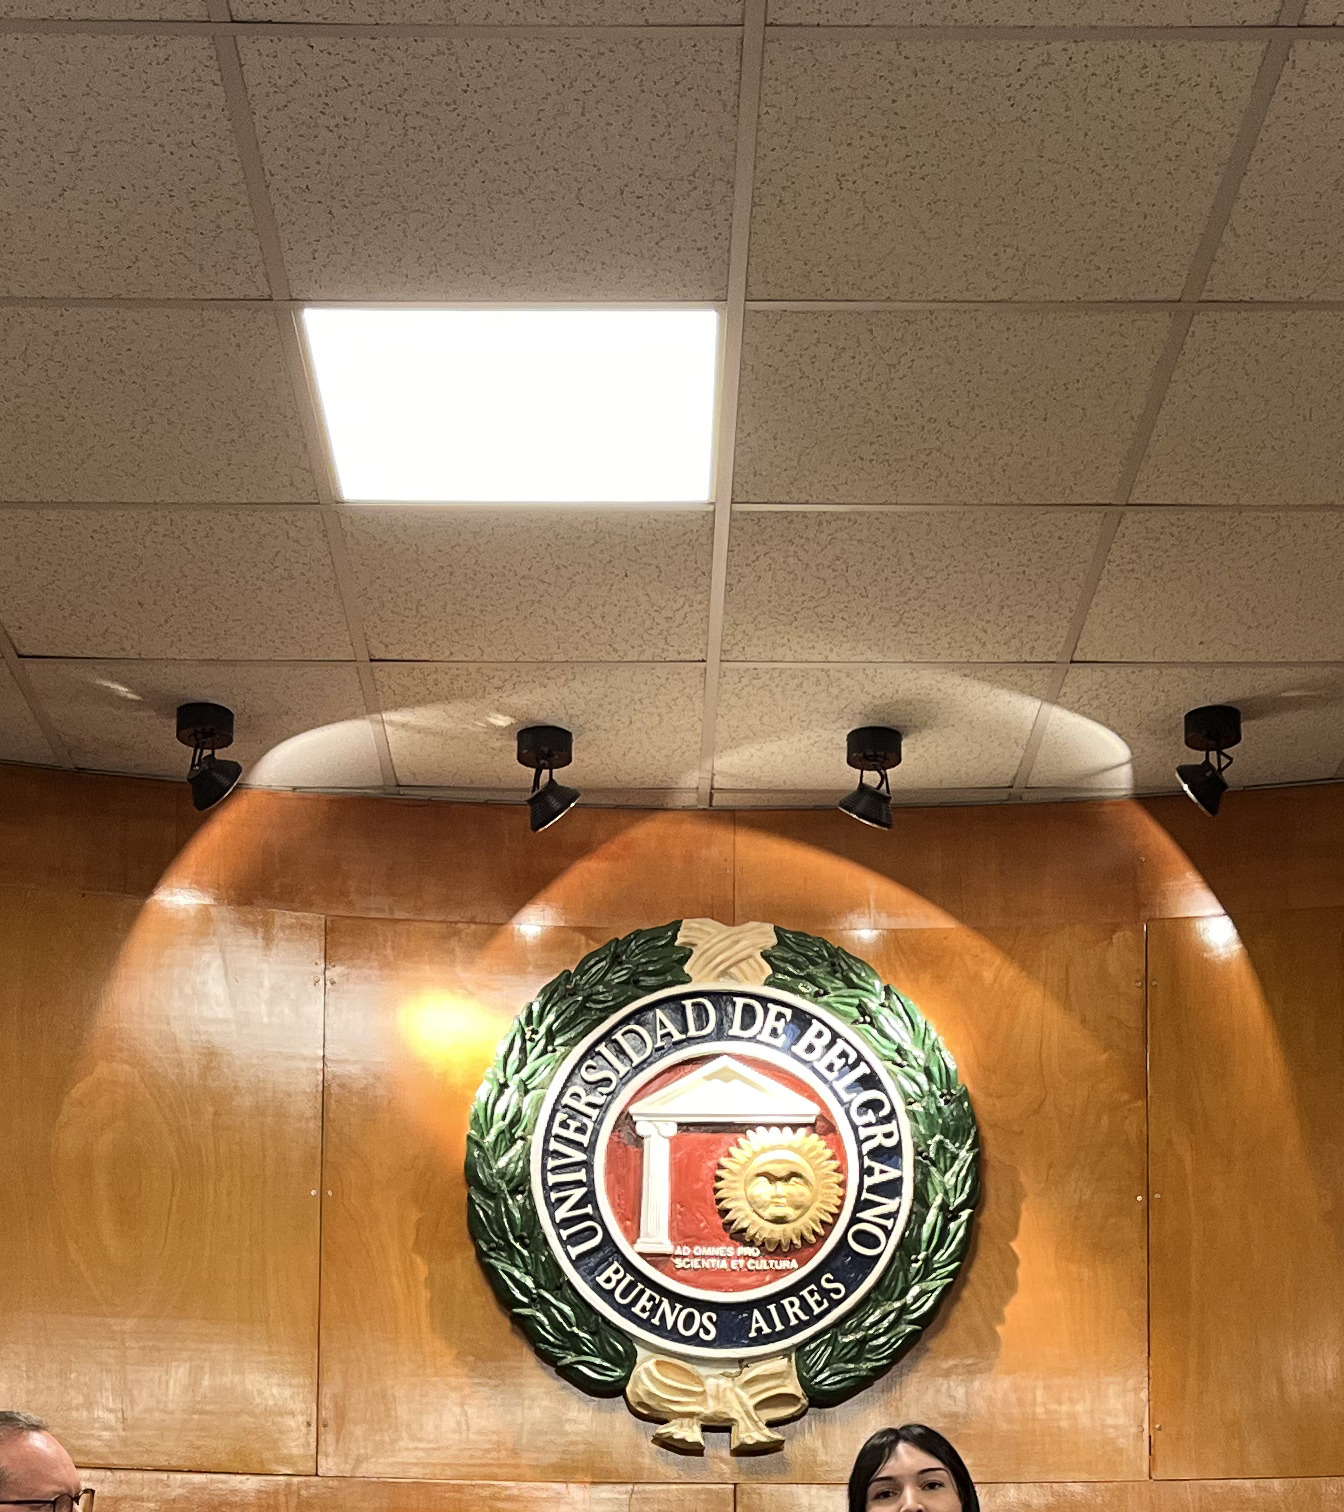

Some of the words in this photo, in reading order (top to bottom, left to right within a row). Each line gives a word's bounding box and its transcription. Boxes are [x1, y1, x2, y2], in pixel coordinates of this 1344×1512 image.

[549, 998, 716, 1260] UNIVERSIDAD
[729, 998, 791, 1047] DE
[791, 1018, 902, 1257] BELGRANO
[674, 1246, 691, 1256] AD
[693, 1246, 735, 1257] OMNES
[737, 1246, 761, 1257] PRO
[674, 1258, 728, 1269] SCIENTIA
[730, 1259, 745, 1269] ET
[746, 1259, 799, 1270] CULTURA
[596, 1263, 717, 1341] BUENOS
[748, 1273, 846, 1338] AIRES
